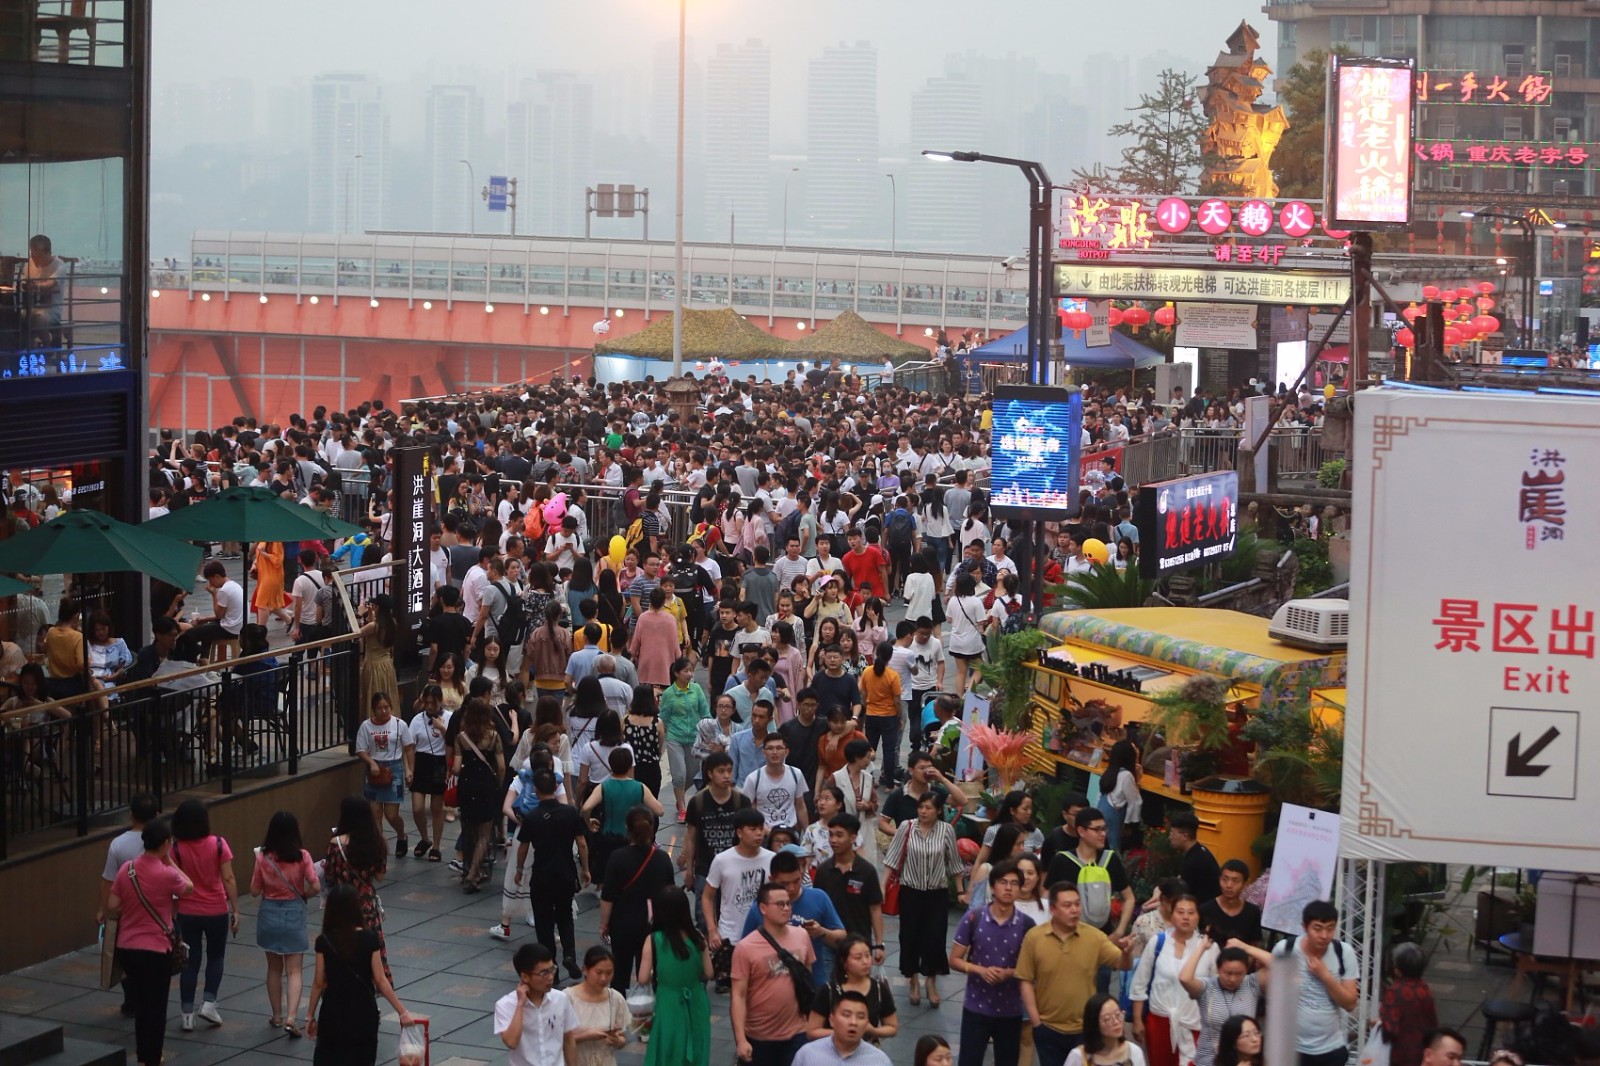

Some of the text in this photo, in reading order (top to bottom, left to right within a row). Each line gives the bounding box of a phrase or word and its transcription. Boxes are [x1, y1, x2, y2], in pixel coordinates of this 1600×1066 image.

[1355, 72, 1396, 201] 地道老火锅
[1466, 145, 1589, 165] 重庆老字号
[1161, 201, 1328, 233] 小天鹅火
[1060, 239, 1099, 249] HONGDING
[1078, 250, 1109, 259] HOTPOT
[1215, 244, 1287, 265] 请至4F
[1099, 273, 1320, 298] 由此乘扶梯转观光电梯 可达洪崖洞各楼层
[412, 474, 424, 613] 洪崖洞大酒店
[1432, 598, 1595, 659] 景区出
[1503, 667, 1570, 694] Exit
[703, 829, 735, 838] TODAY
[707, 839, 732, 848] TAKE
[742, 869, 761, 886] NYC
